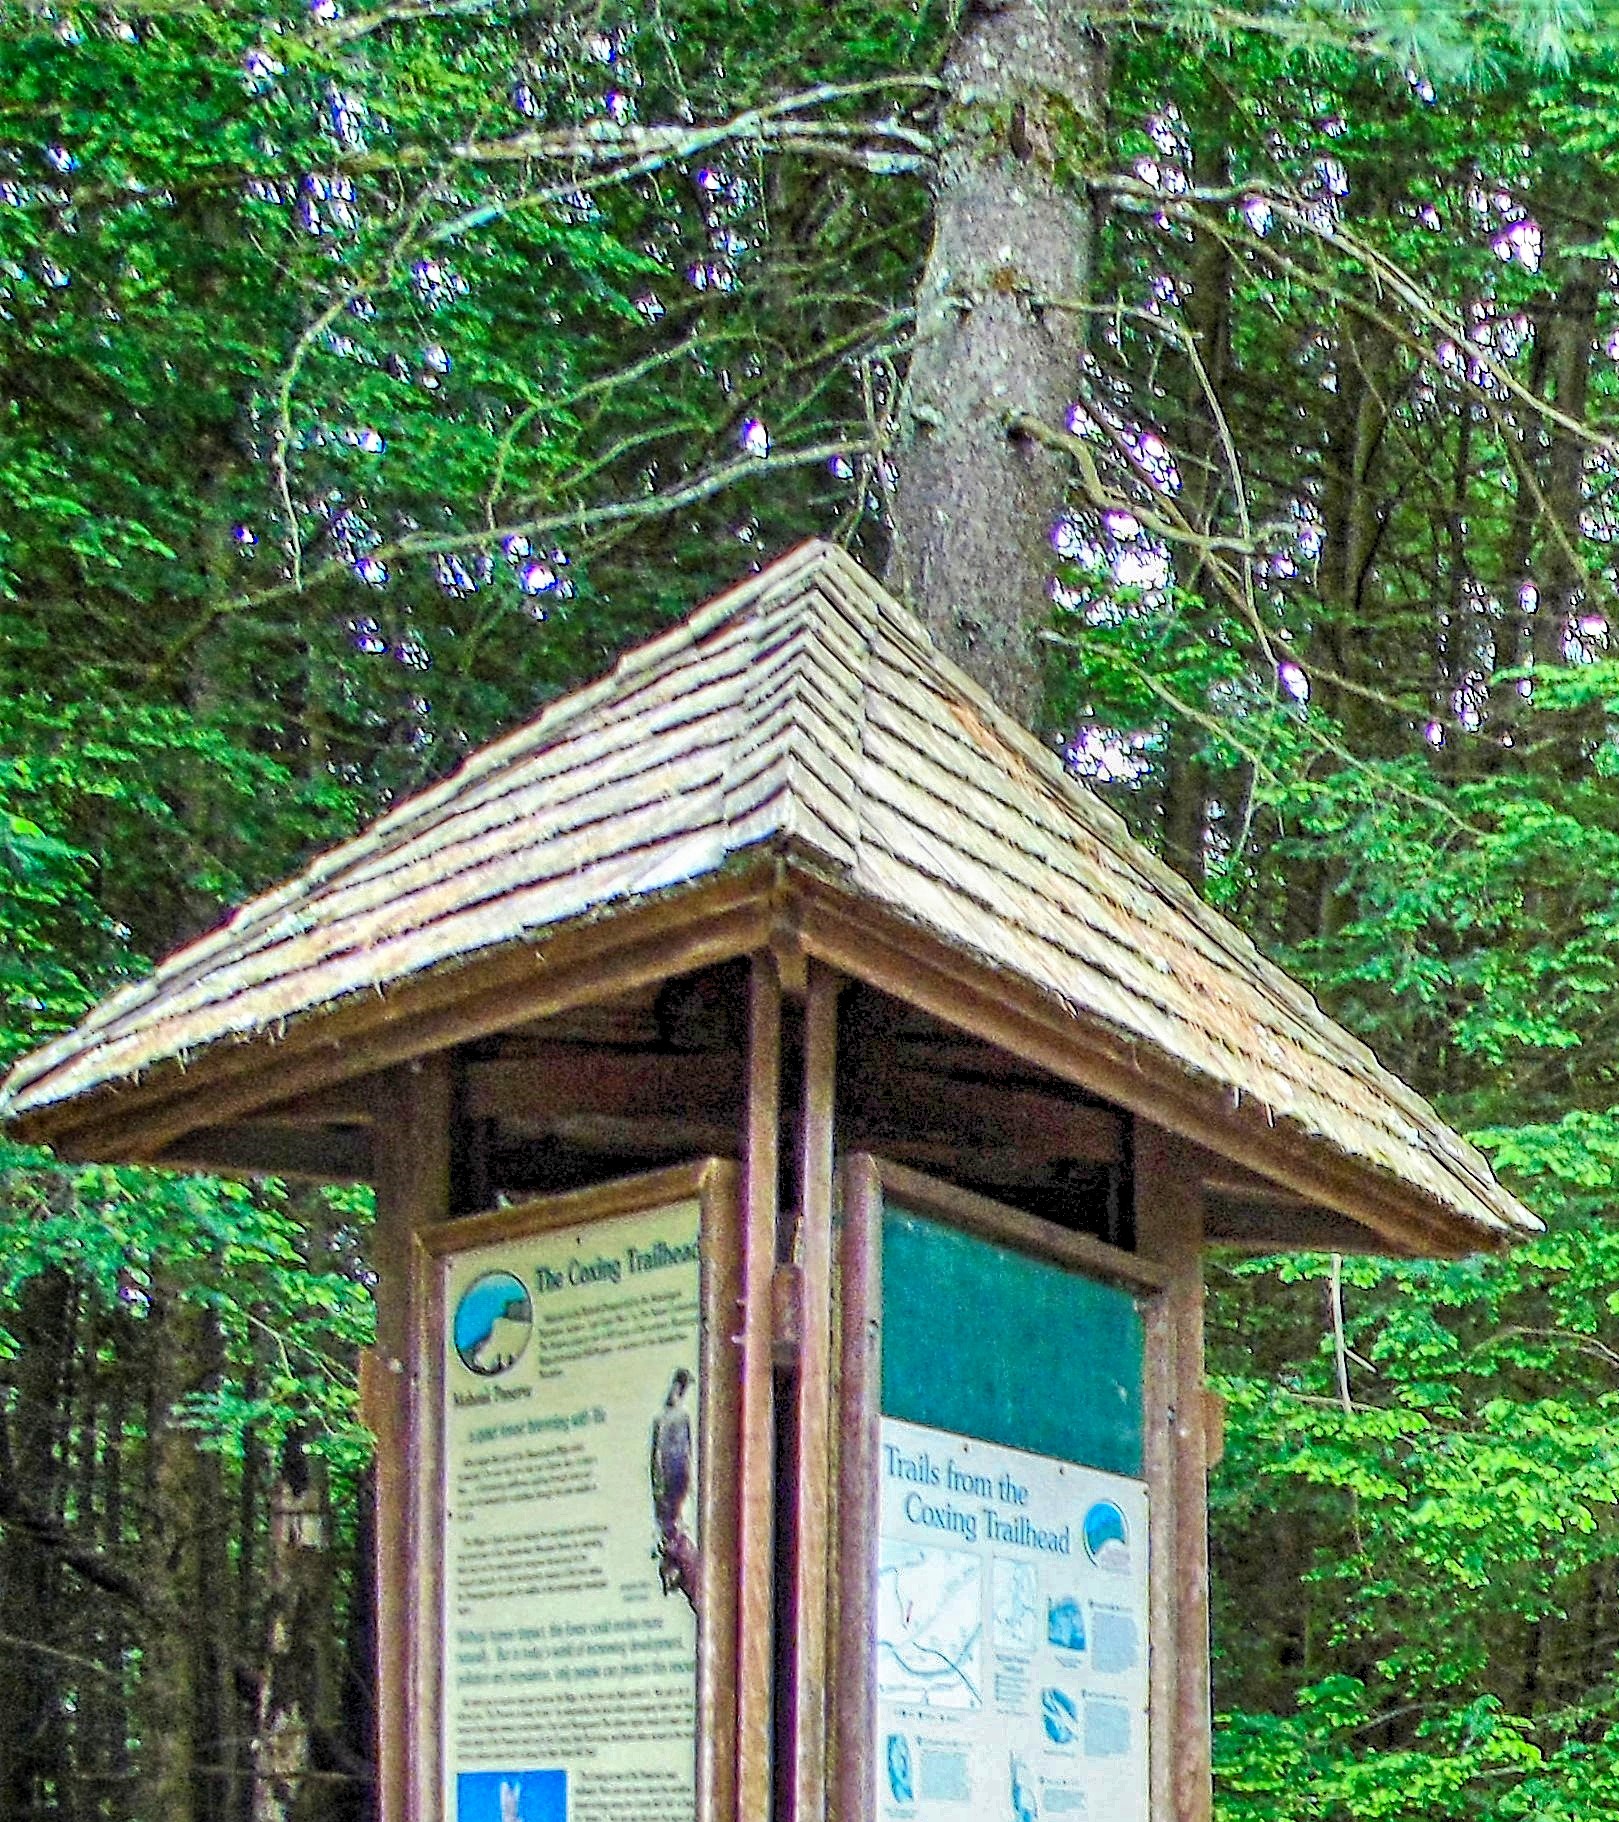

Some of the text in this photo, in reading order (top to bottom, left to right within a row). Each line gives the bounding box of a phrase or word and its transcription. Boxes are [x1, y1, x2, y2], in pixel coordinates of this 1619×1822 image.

[535, 1264, 564, 1293] The
[568, 1257, 622, 1284] Coxing
[885, 1443, 1029, 1506] Trails from the
[904, 1491, 1072, 1554] Coxing Trailhead
